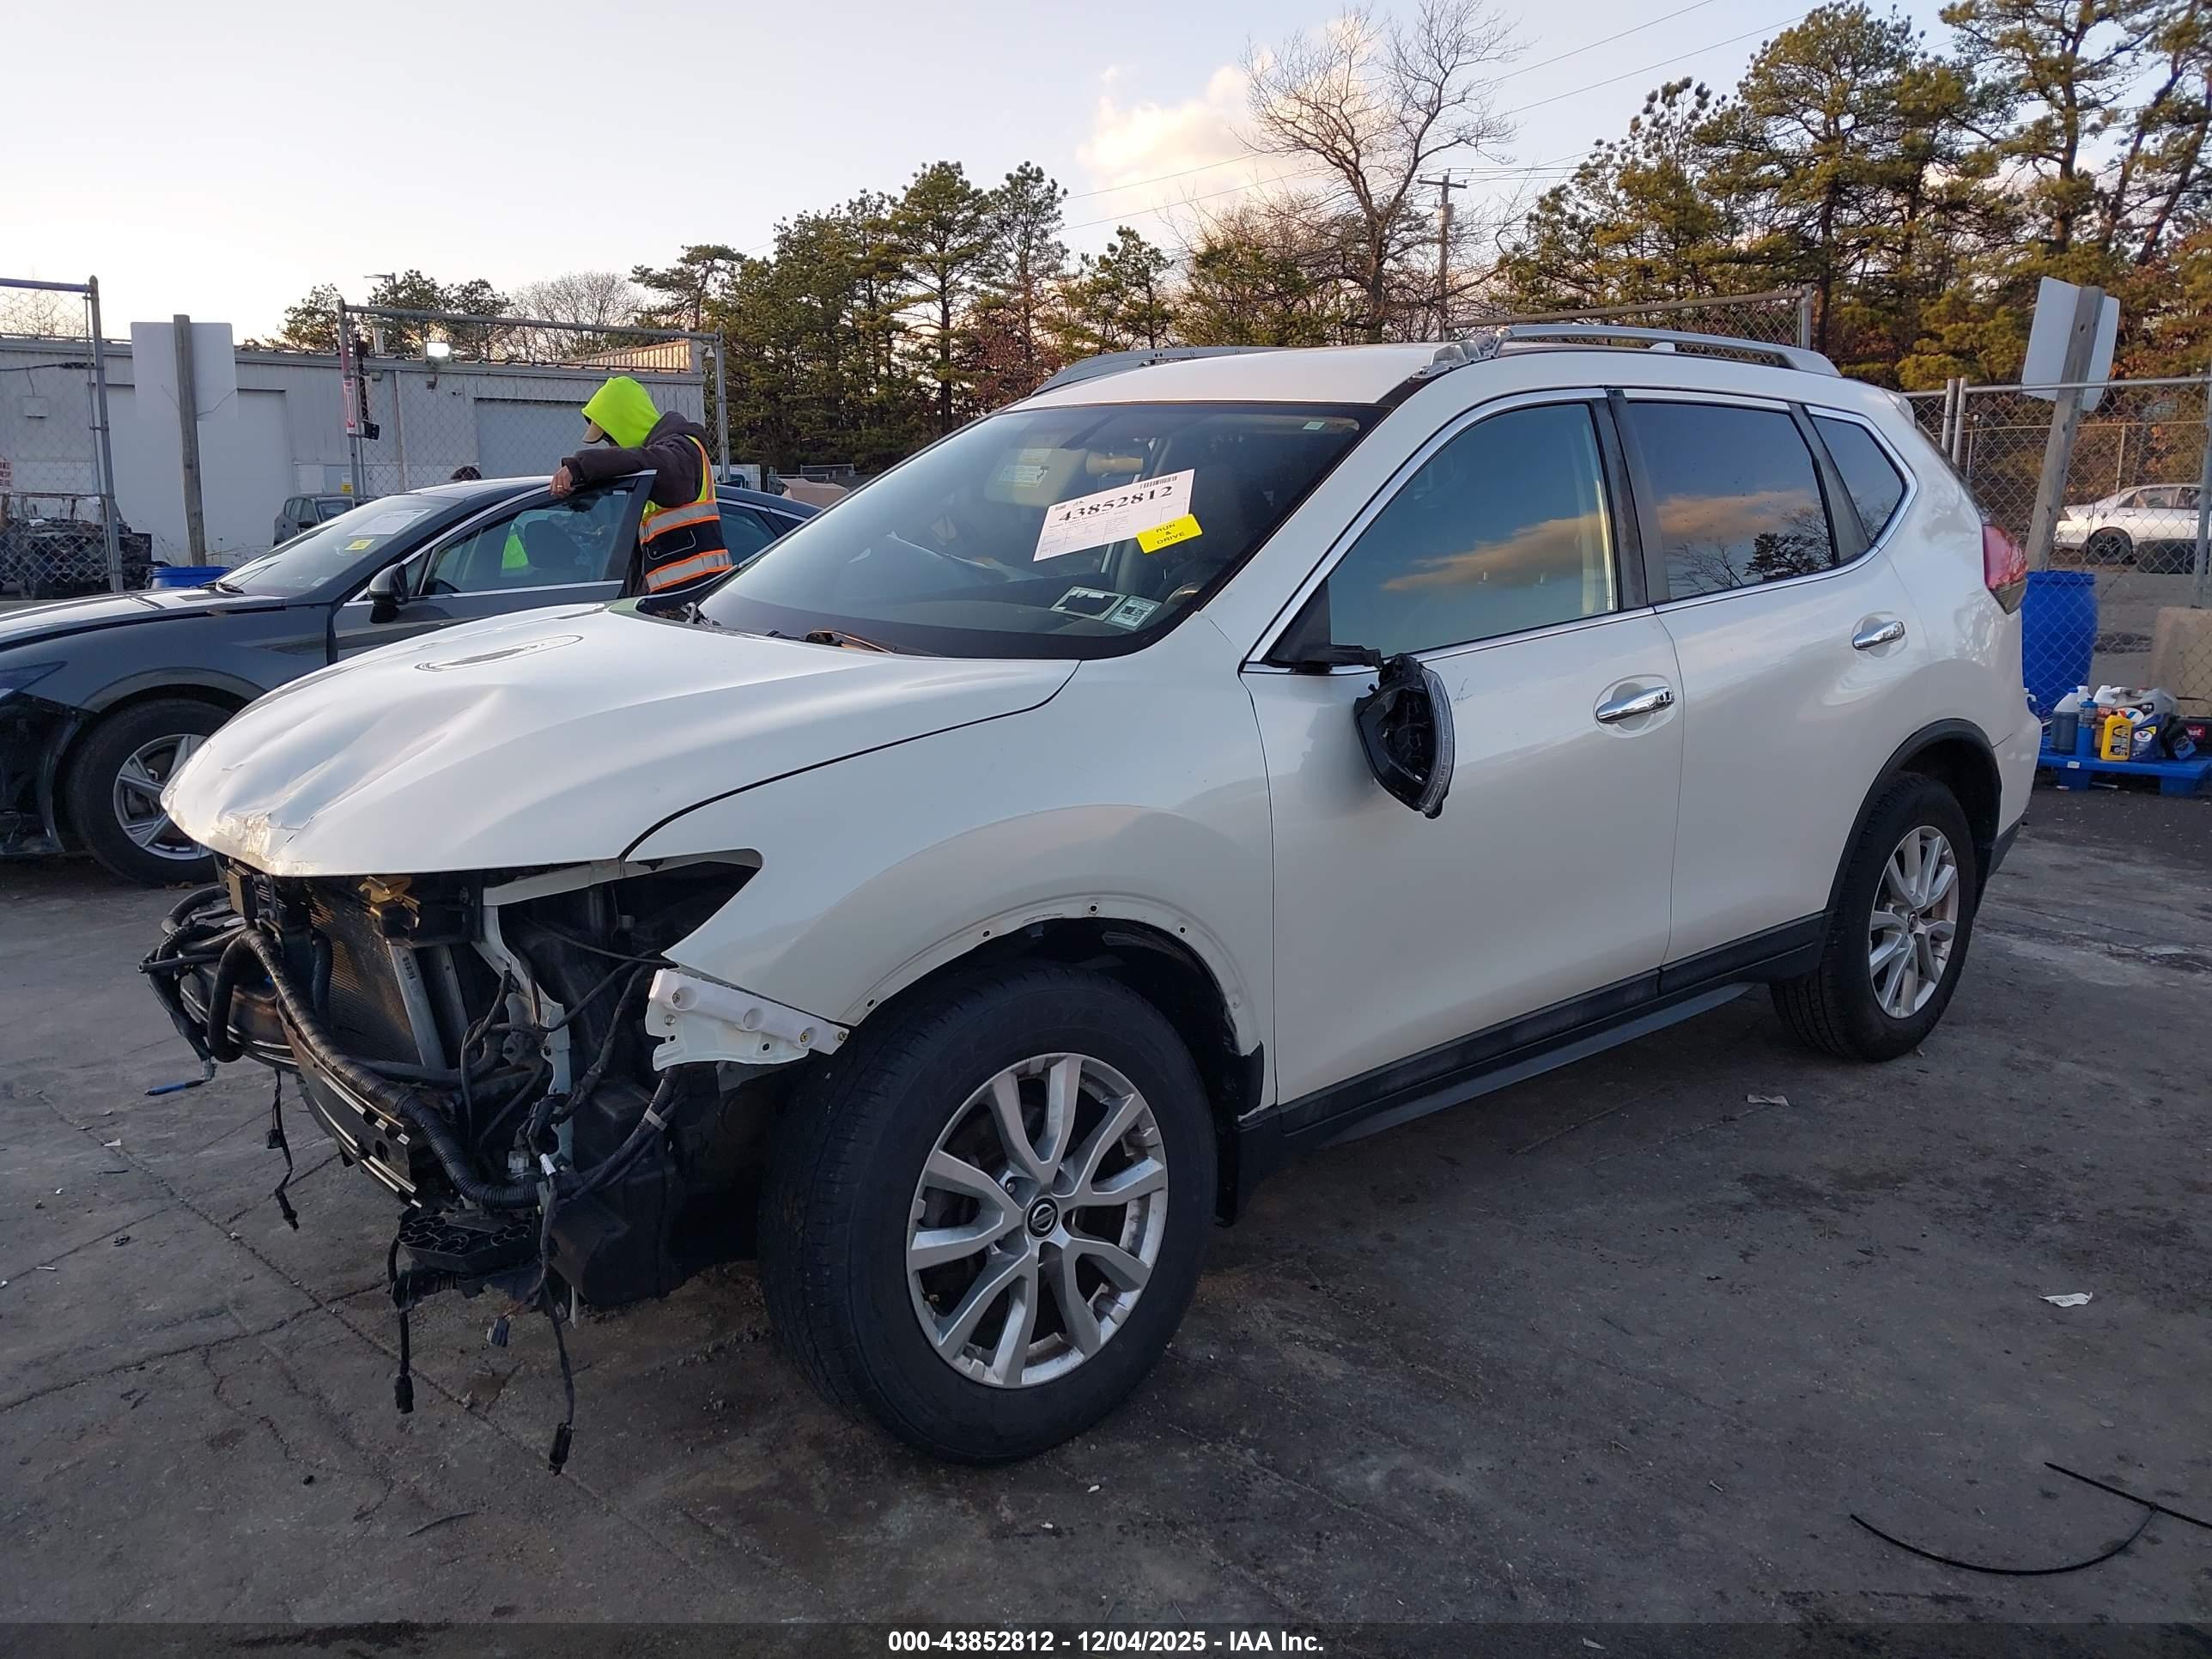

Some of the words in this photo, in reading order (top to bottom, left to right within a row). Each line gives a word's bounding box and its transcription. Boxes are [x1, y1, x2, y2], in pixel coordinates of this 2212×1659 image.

[1058, 486, 1173, 521] 43852812
[1156, 523, 1176, 533] RUN
[1157, 532, 1185, 544] DRIVE
